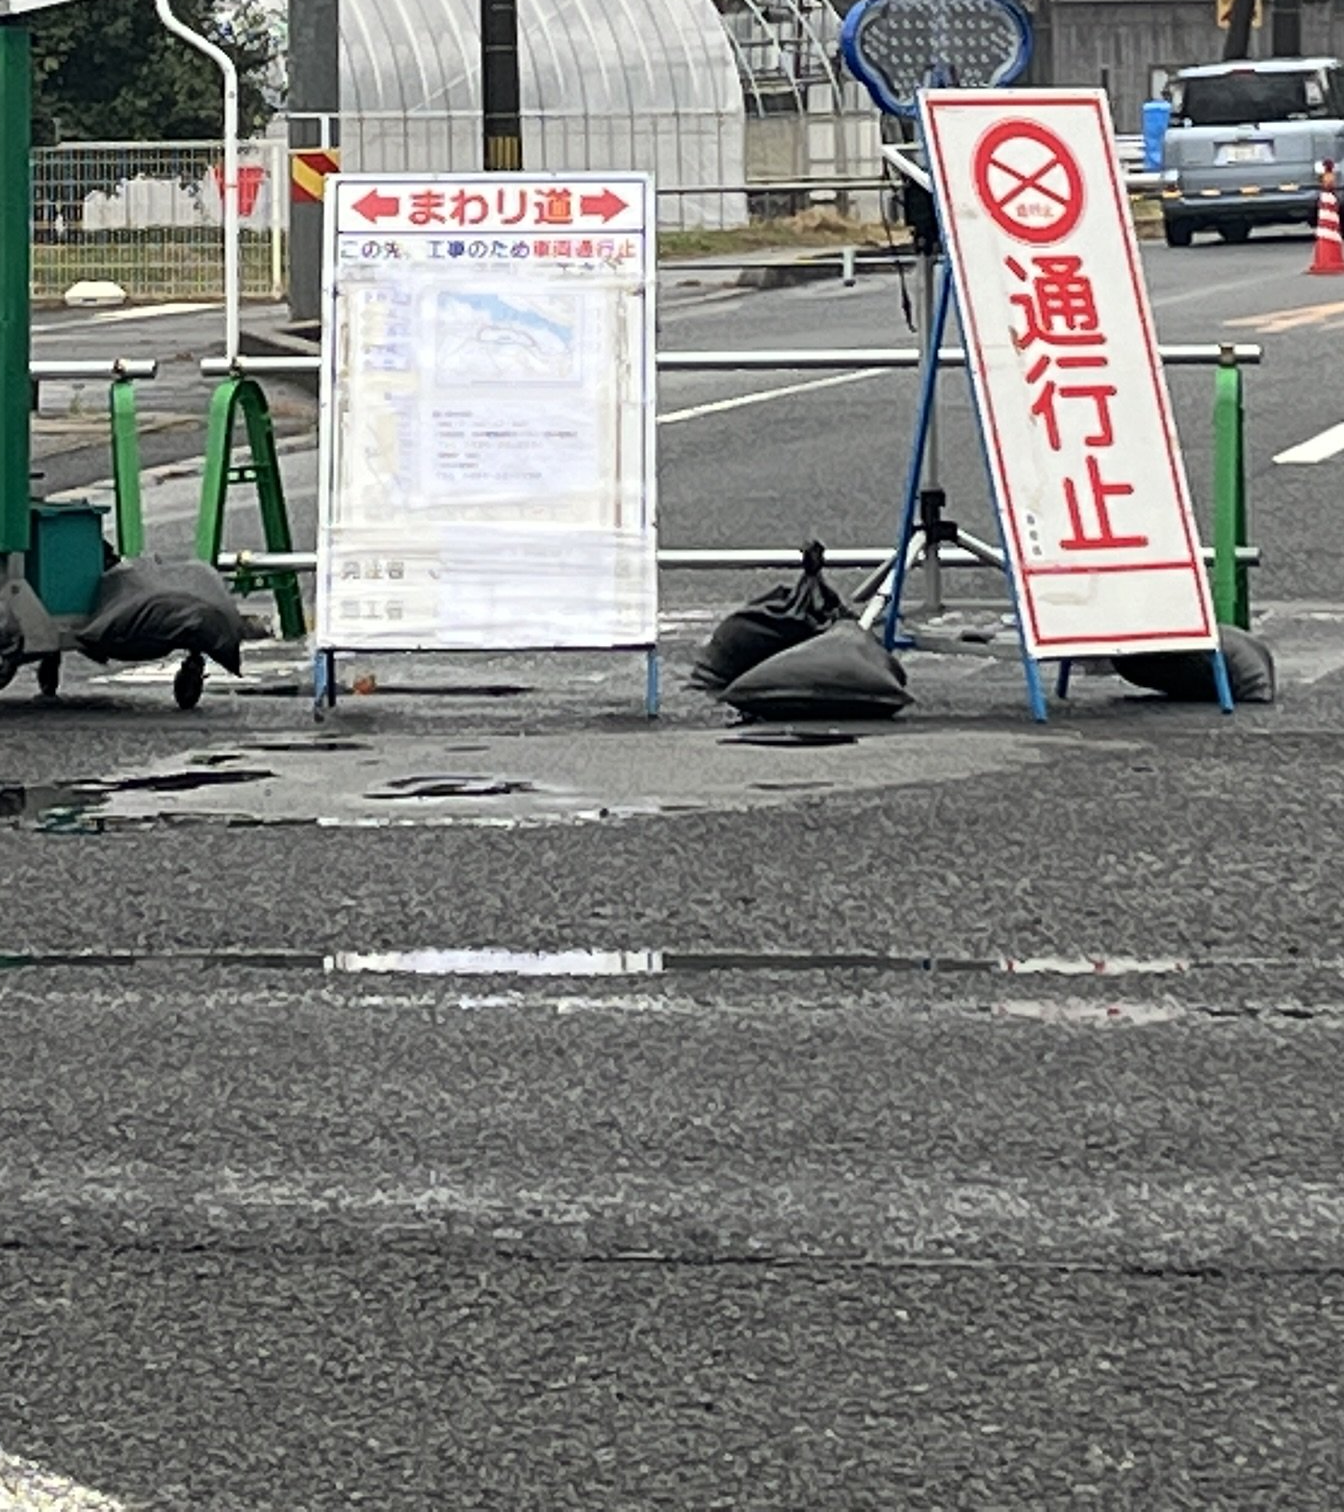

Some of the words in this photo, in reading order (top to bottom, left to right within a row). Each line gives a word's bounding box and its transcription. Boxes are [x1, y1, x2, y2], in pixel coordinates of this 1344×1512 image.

[408, 188, 574, 225] まわり道
[1004, 254, 1149, 551] 通行止
